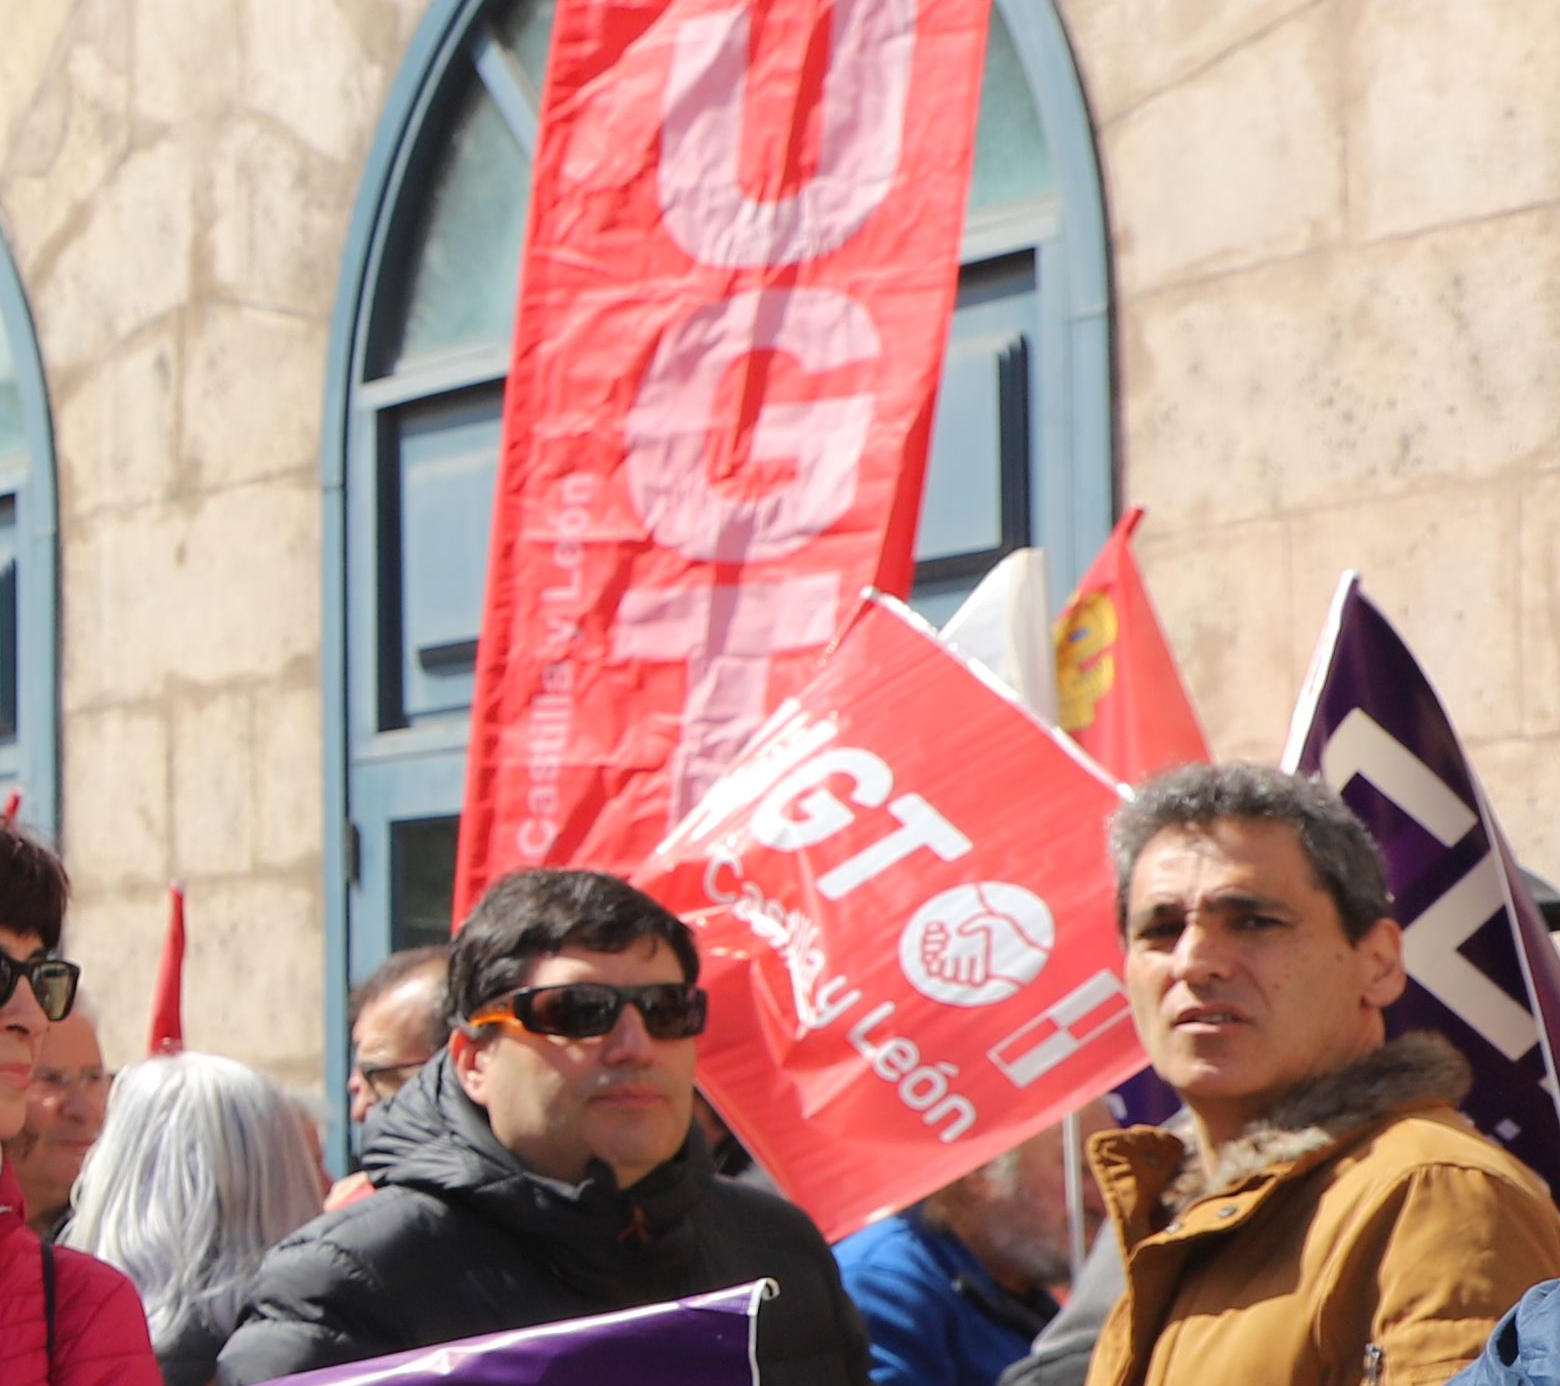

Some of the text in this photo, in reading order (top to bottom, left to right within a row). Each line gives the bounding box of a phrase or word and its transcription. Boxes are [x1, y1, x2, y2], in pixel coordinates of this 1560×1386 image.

[540, 472, 593, 603] León
[515, 659, 576, 857] Castilla
[715, 718, 974, 901] GT
[808, 974, 863, 1030] y
[846, 999, 978, 1144] León
